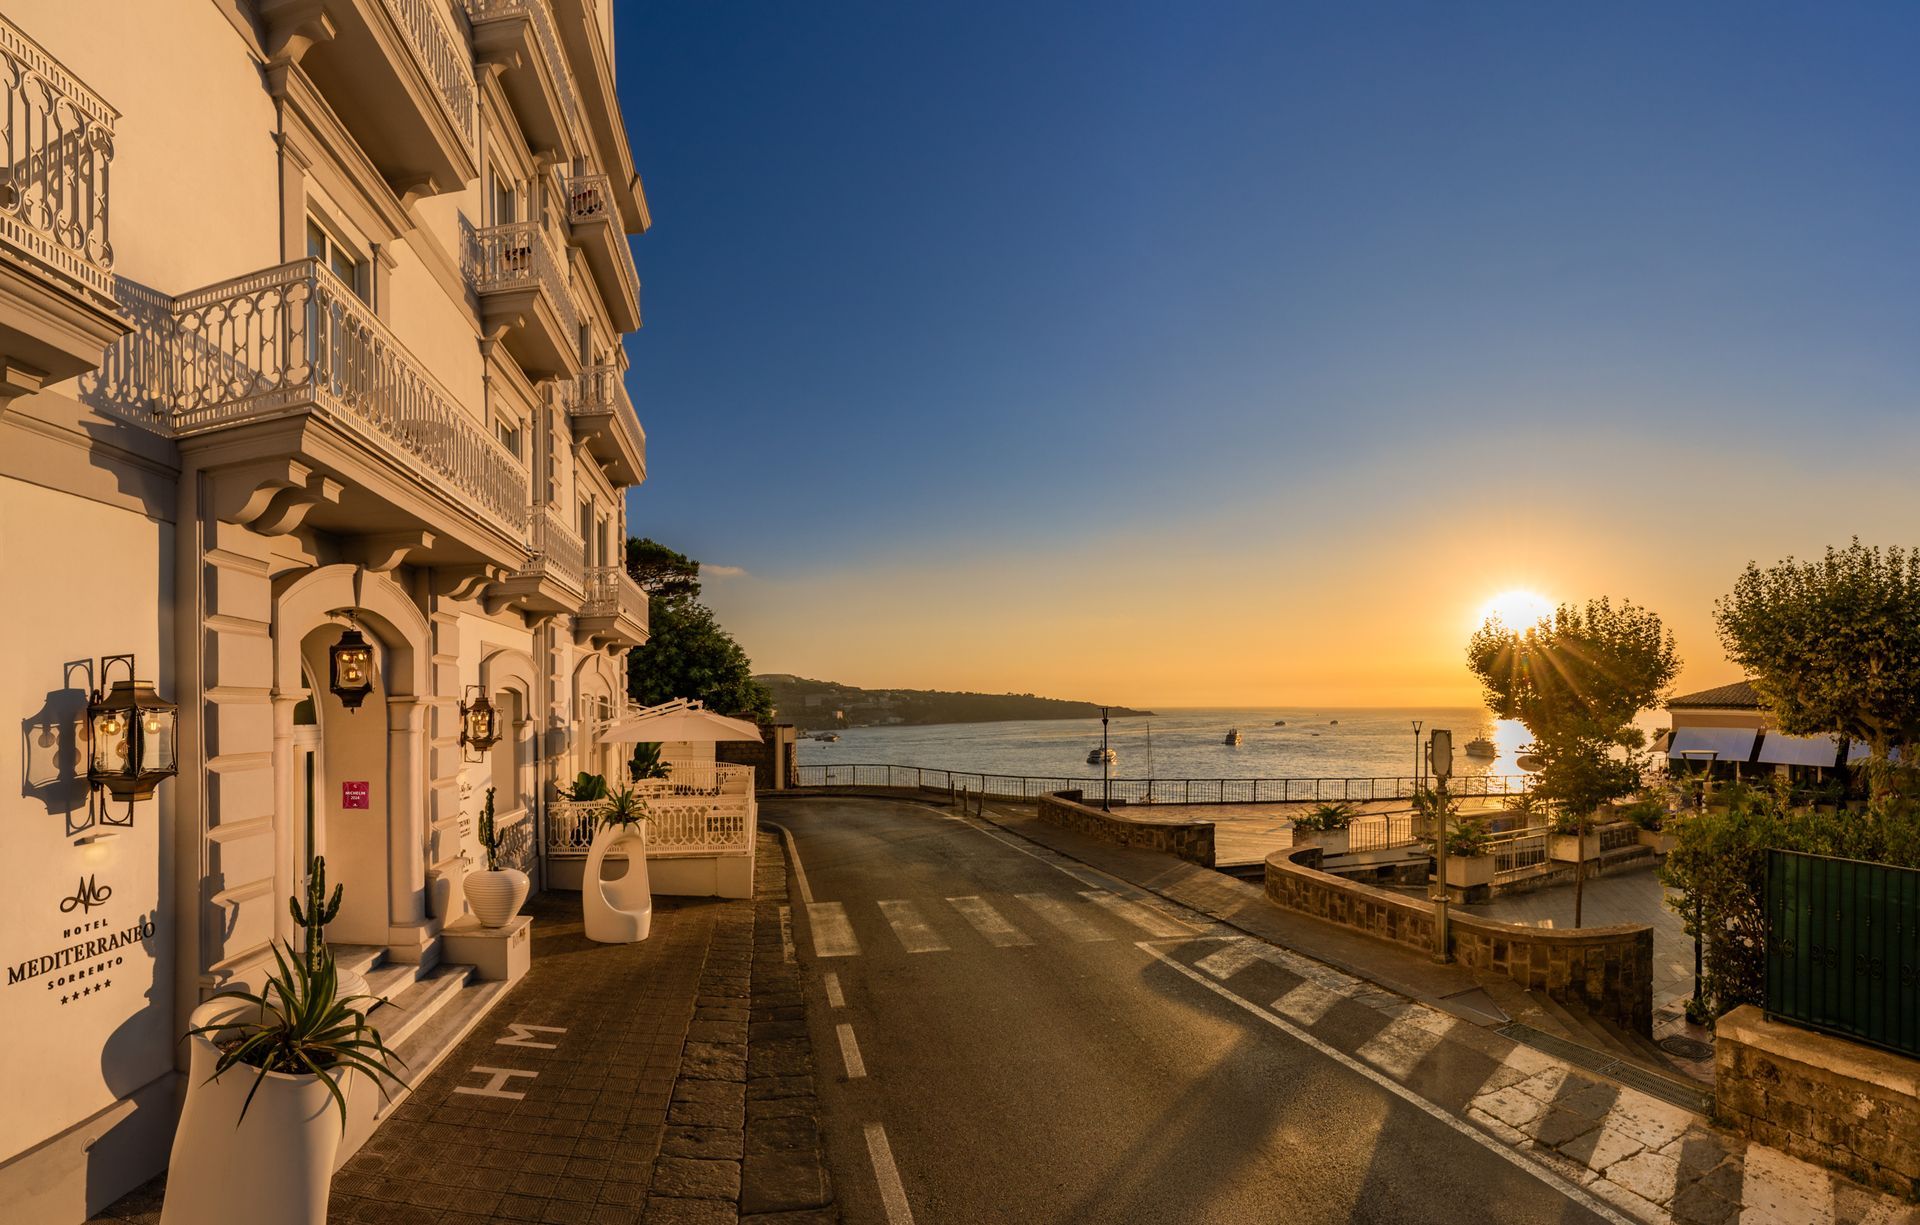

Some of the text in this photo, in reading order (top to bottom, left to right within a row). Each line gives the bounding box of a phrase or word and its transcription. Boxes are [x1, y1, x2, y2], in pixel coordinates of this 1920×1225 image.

[63, 918, 108, 938] HOTEL
[7, 922, 156, 985] MEDITERRANEO
[47, 957, 123, 990] SORRENTO
